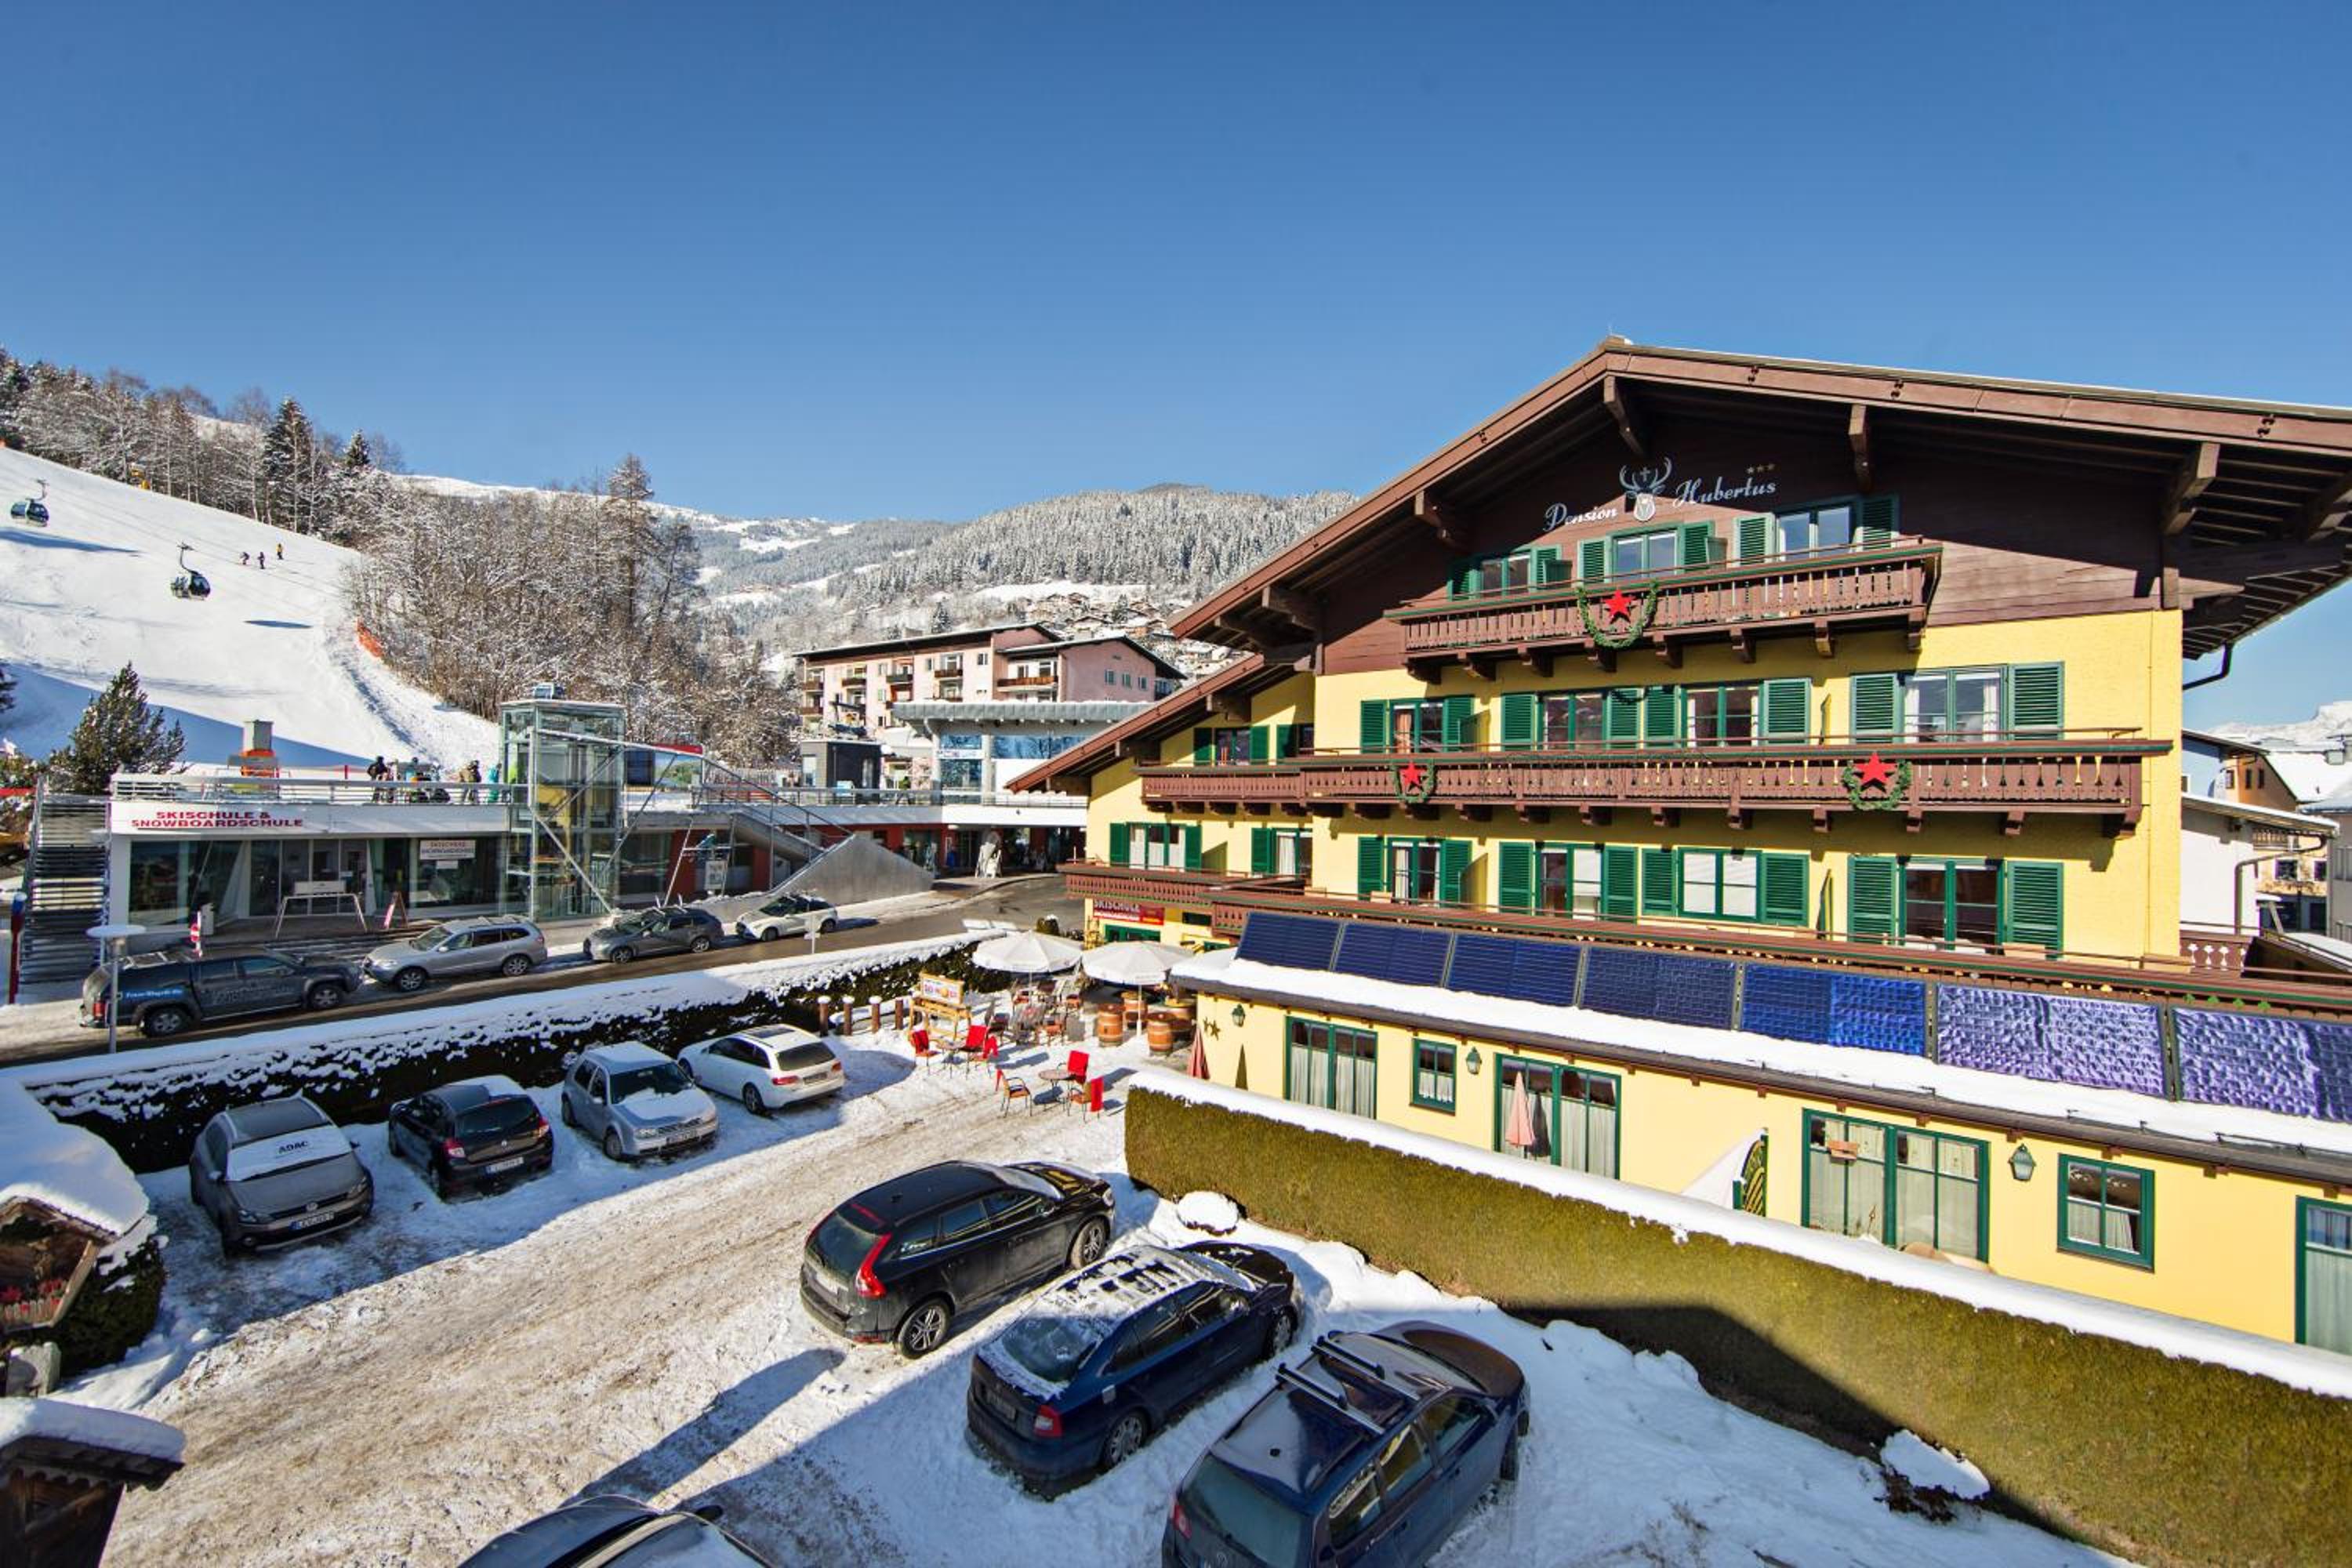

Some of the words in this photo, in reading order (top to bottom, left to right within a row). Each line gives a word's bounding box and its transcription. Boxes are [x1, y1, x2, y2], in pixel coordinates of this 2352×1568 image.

[1543, 503, 1618, 531] Pension
[1672, 476, 1777, 508] Hubertus
[278, 1142, 307, 1153] ADAC
